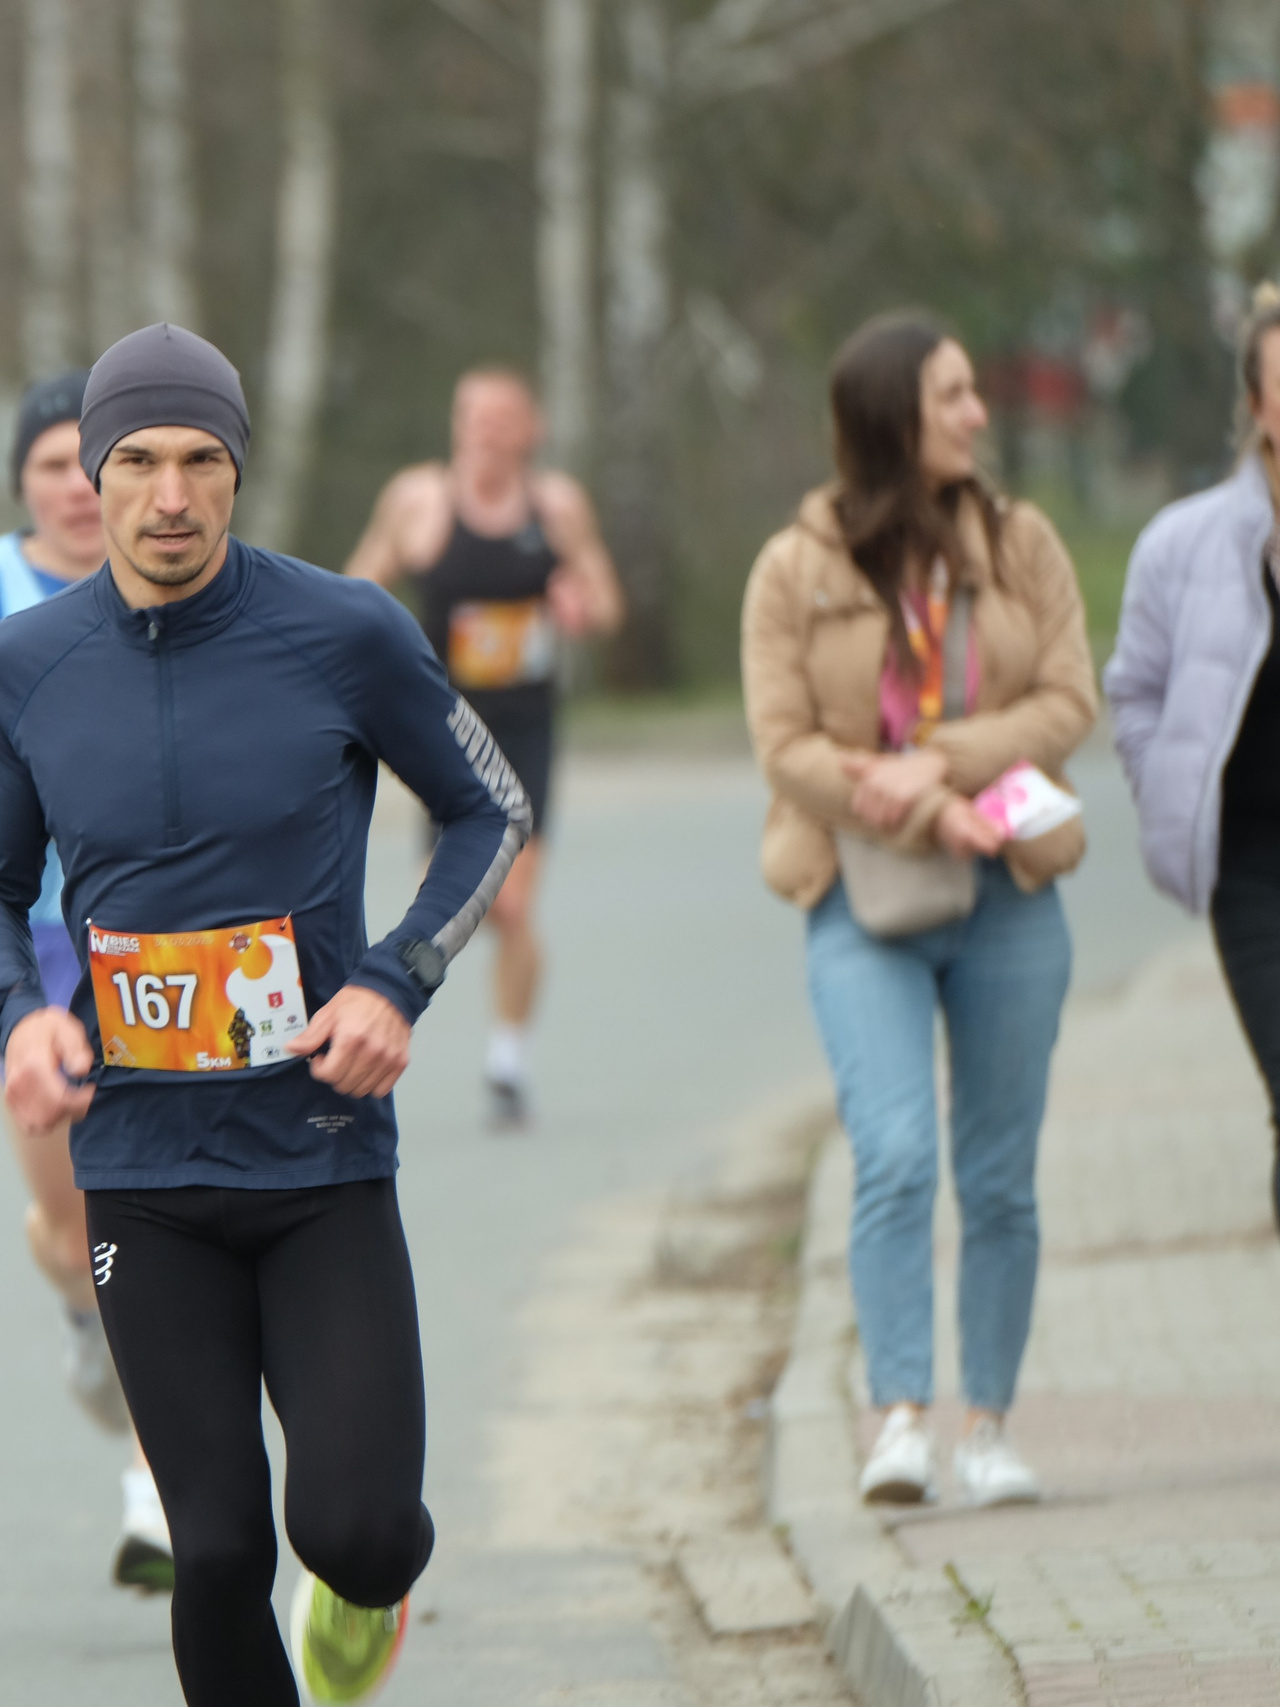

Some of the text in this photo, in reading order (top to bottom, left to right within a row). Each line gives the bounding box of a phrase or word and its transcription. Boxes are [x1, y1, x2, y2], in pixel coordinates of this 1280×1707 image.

[109, 935, 140, 947] BIEG
[112, 971, 199, 1030] 167
[196, 1051, 232, 1069] 5KM
